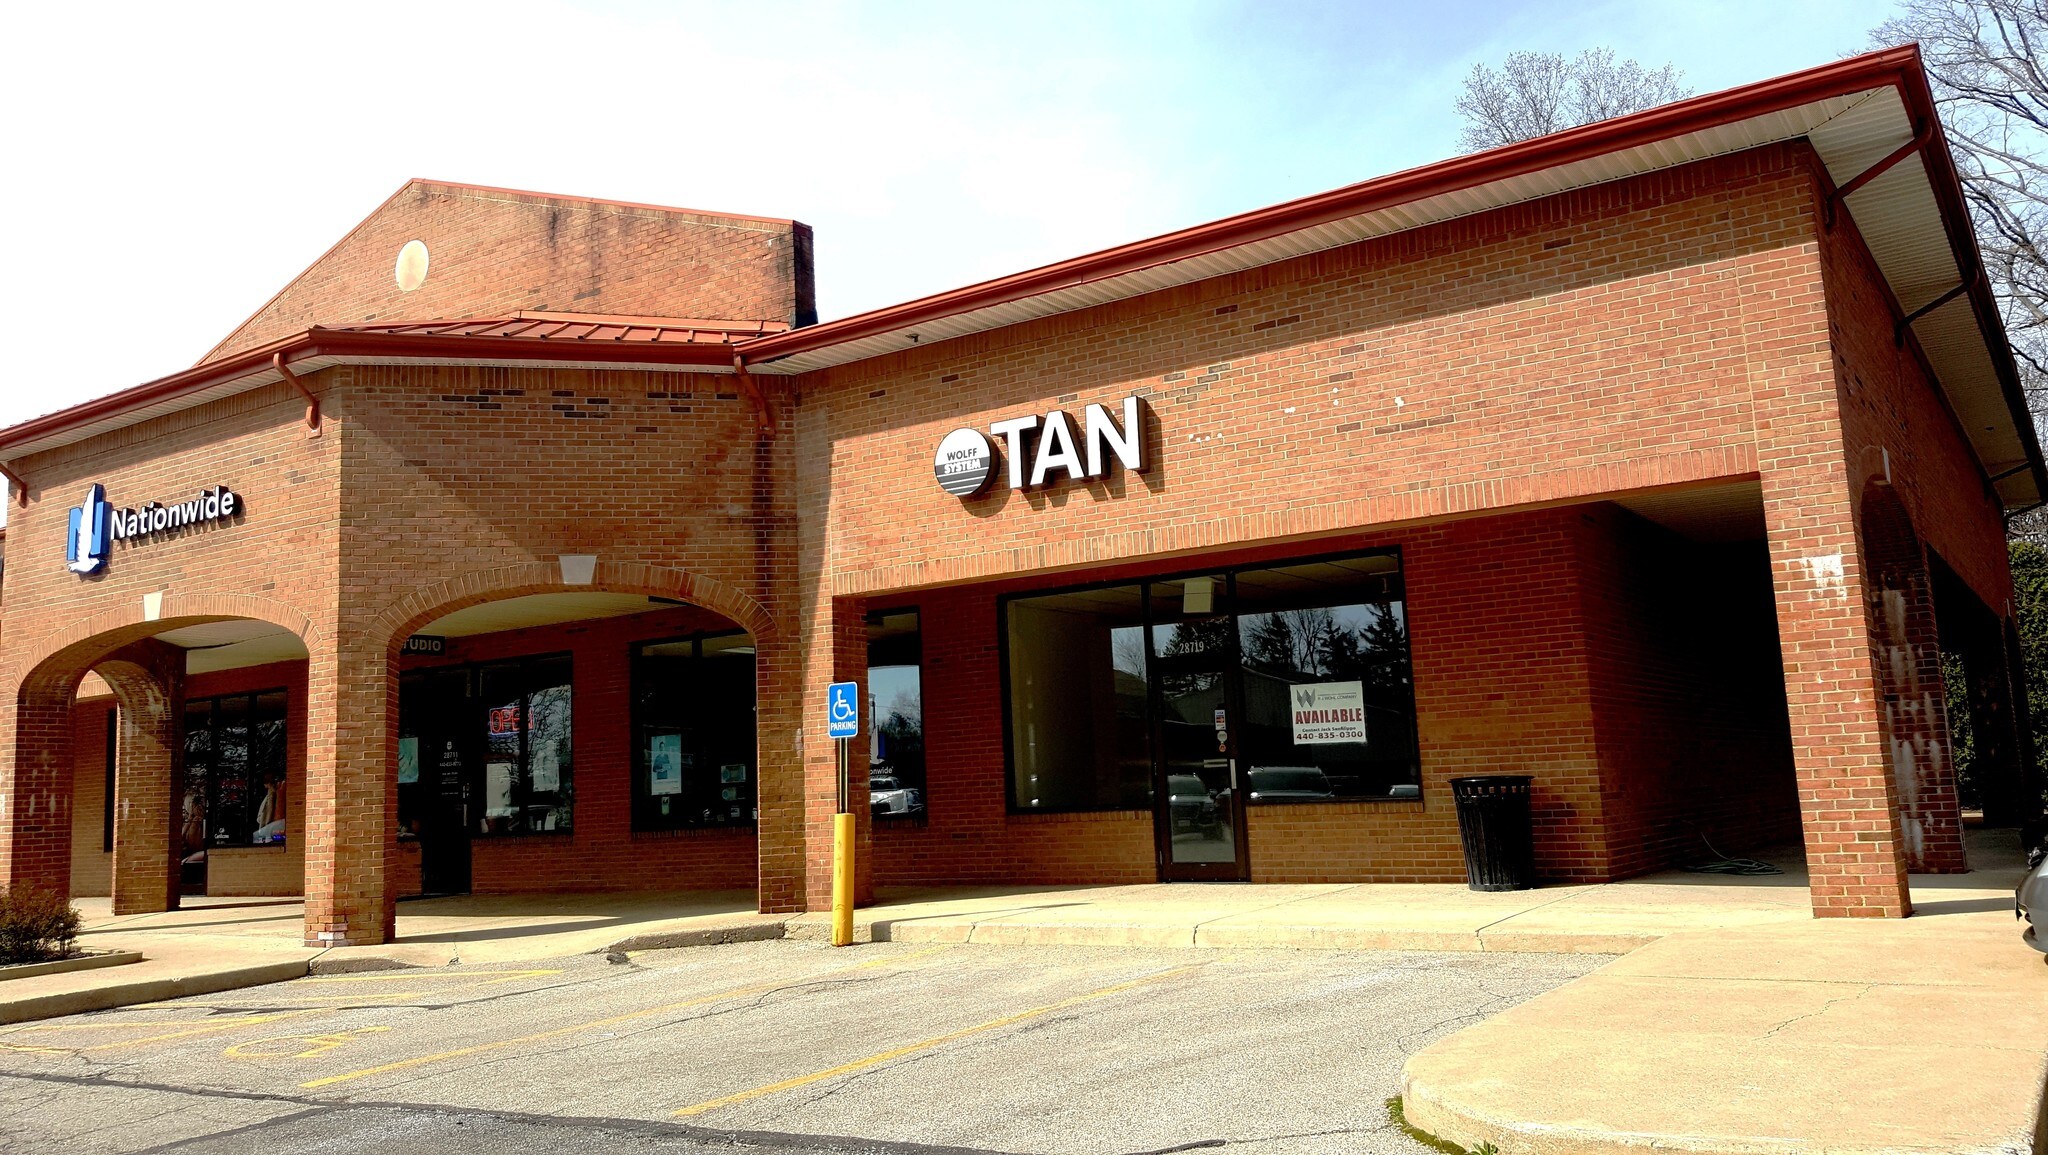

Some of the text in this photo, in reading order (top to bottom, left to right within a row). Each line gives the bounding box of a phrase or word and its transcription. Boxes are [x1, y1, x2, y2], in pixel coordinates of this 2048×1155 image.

[990, 395, 1143, 490] TAN
[946, 447, 978, 460] WOLFF
[943, 458, 981, 474] SYSTEM
[110, 485, 235, 541] Nationwide
[403, 639, 442, 652] TUDIO
[1179, 640, 1205, 654] 28719
[1295, 708, 1362, 724] AVAILABLE
[830, 721, 856, 731] PARKING
[1296, 731, 1363, 740] 440-835-0300
